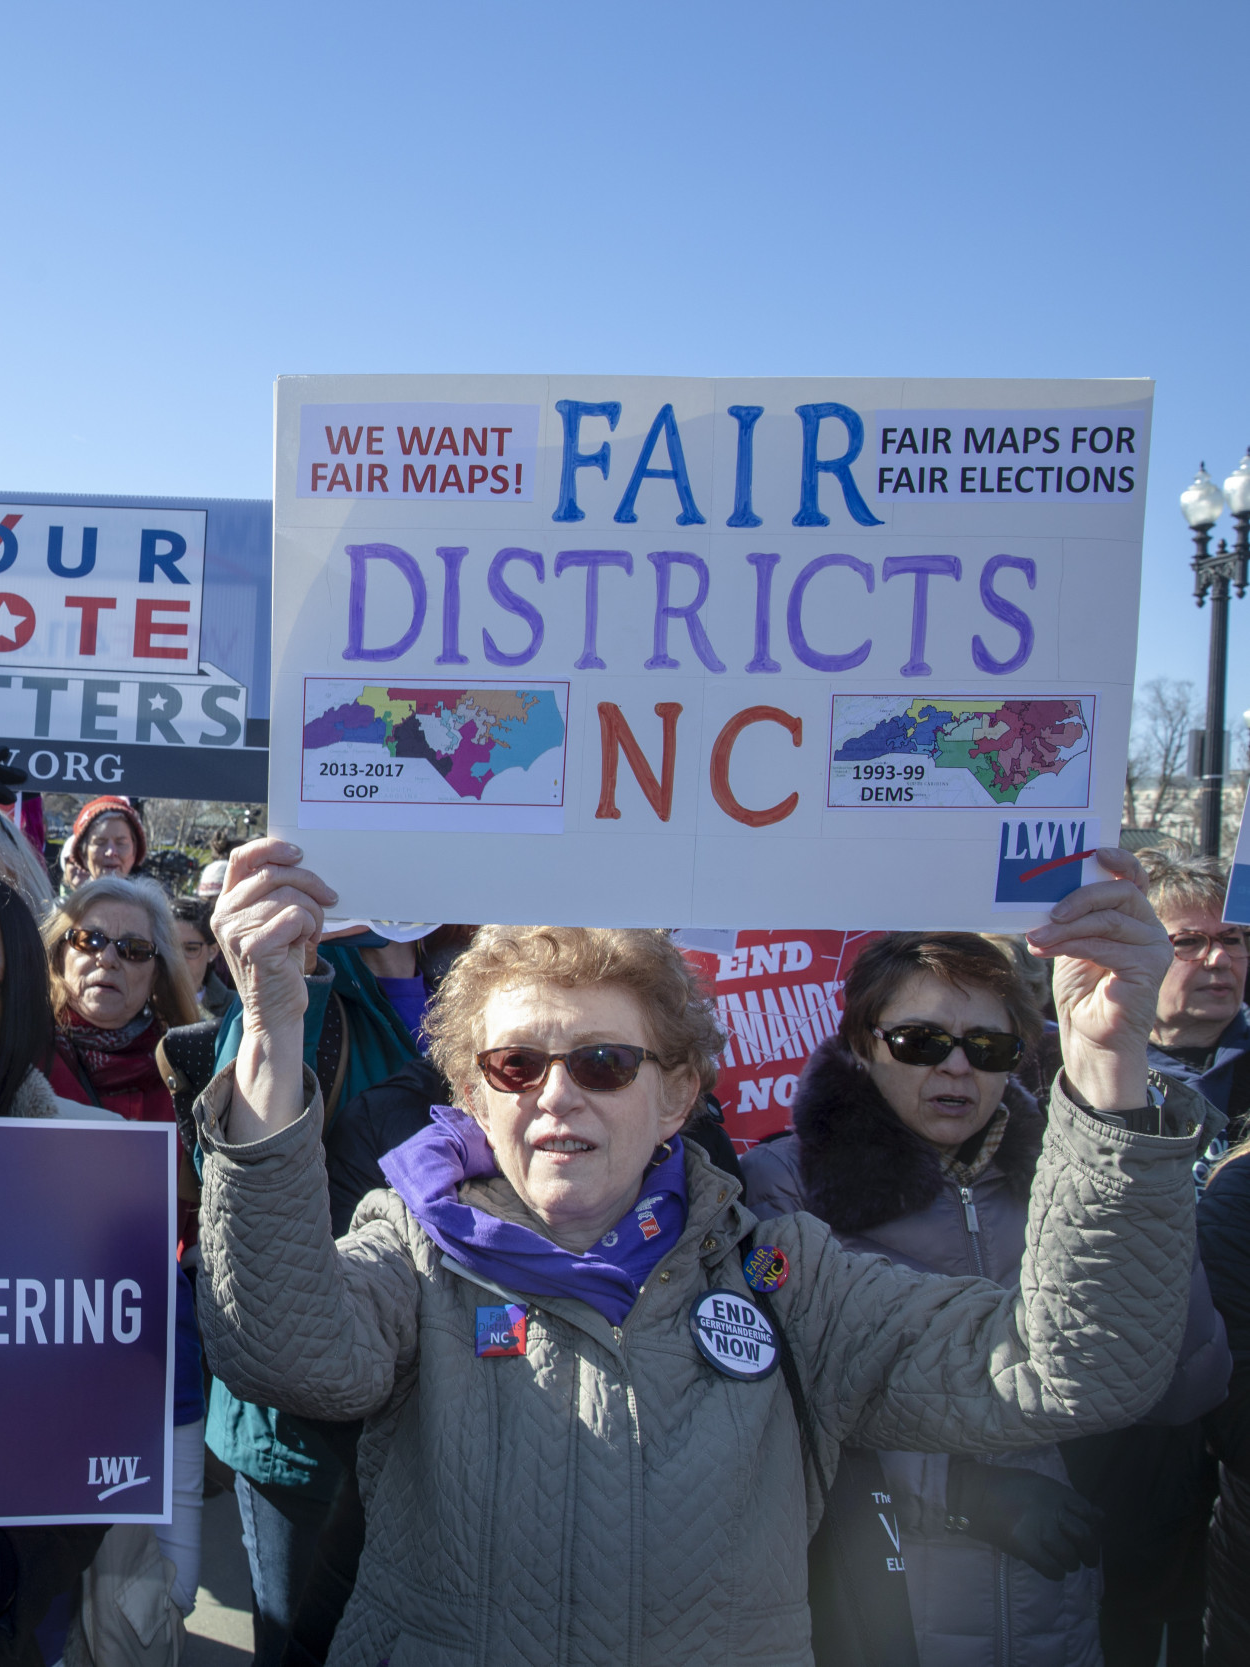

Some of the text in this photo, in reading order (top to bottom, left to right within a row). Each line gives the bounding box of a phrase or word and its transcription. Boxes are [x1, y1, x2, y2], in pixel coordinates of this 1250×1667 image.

[324, 425, 513, 457] WE WANT
[880, 426, 1136, 455] FAIR MAPS FOR
[552, 398, 885, 528] FAIR
[310, 462, 523, 495] FAIR MAPS!
[877, 465, 1135, 494] FAIR ELECTIONS
[342, 542, 1038, 676] DISTRICTS
[319, 762, 404, 778] 2013-2017
[594, 701, 803, 828] NC
[852, 764, 925, 780] 1993-99
[343, 784, 379, 799] GOP
[860, 787, 914, 802] DEMS
[1003, 821, 1087, 860] LWV
[715, 940, 813, 983] END
[745, 1248, 768, 1276] FAIR
[750, 1249, 779, 1287] DISTRICTS
[762, 1262, 784, 1286] NC
[489, 1311, 509, 1321] Fair
[712, 1298, 756, 1326] END
[478, 1322, 523, 1332] Districts
[490, 1331, 509, 1344] NC
[700, 1317, 772, 1343] GERRYMANDERING
[715, 1334, 761, 1362] NOW
[87, 1456, 140, 1485] LWV
